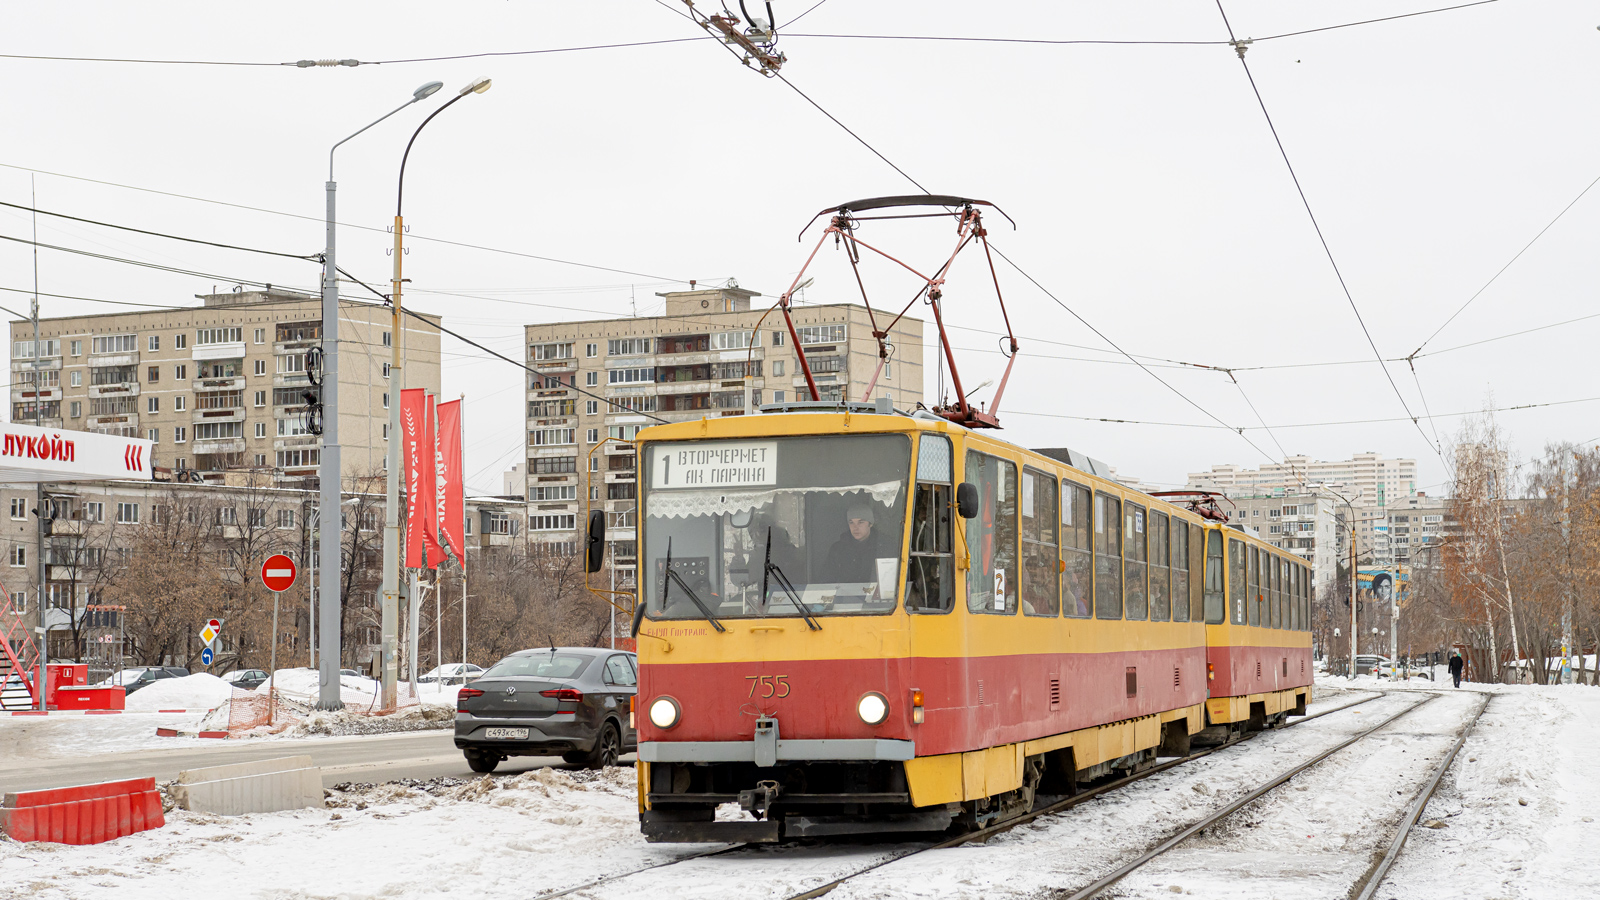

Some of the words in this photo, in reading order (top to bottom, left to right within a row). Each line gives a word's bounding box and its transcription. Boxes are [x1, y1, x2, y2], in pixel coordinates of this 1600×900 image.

[2, 433, 75, 462] ЛУКОЙЛ
[678, 447, 767, 466] ВТОРЧЕРМЕТ
[662, 455, 670, 485] 1
[711, 467, 766, 483] ПАРИНА
[745, 674, 791, 699] 755
